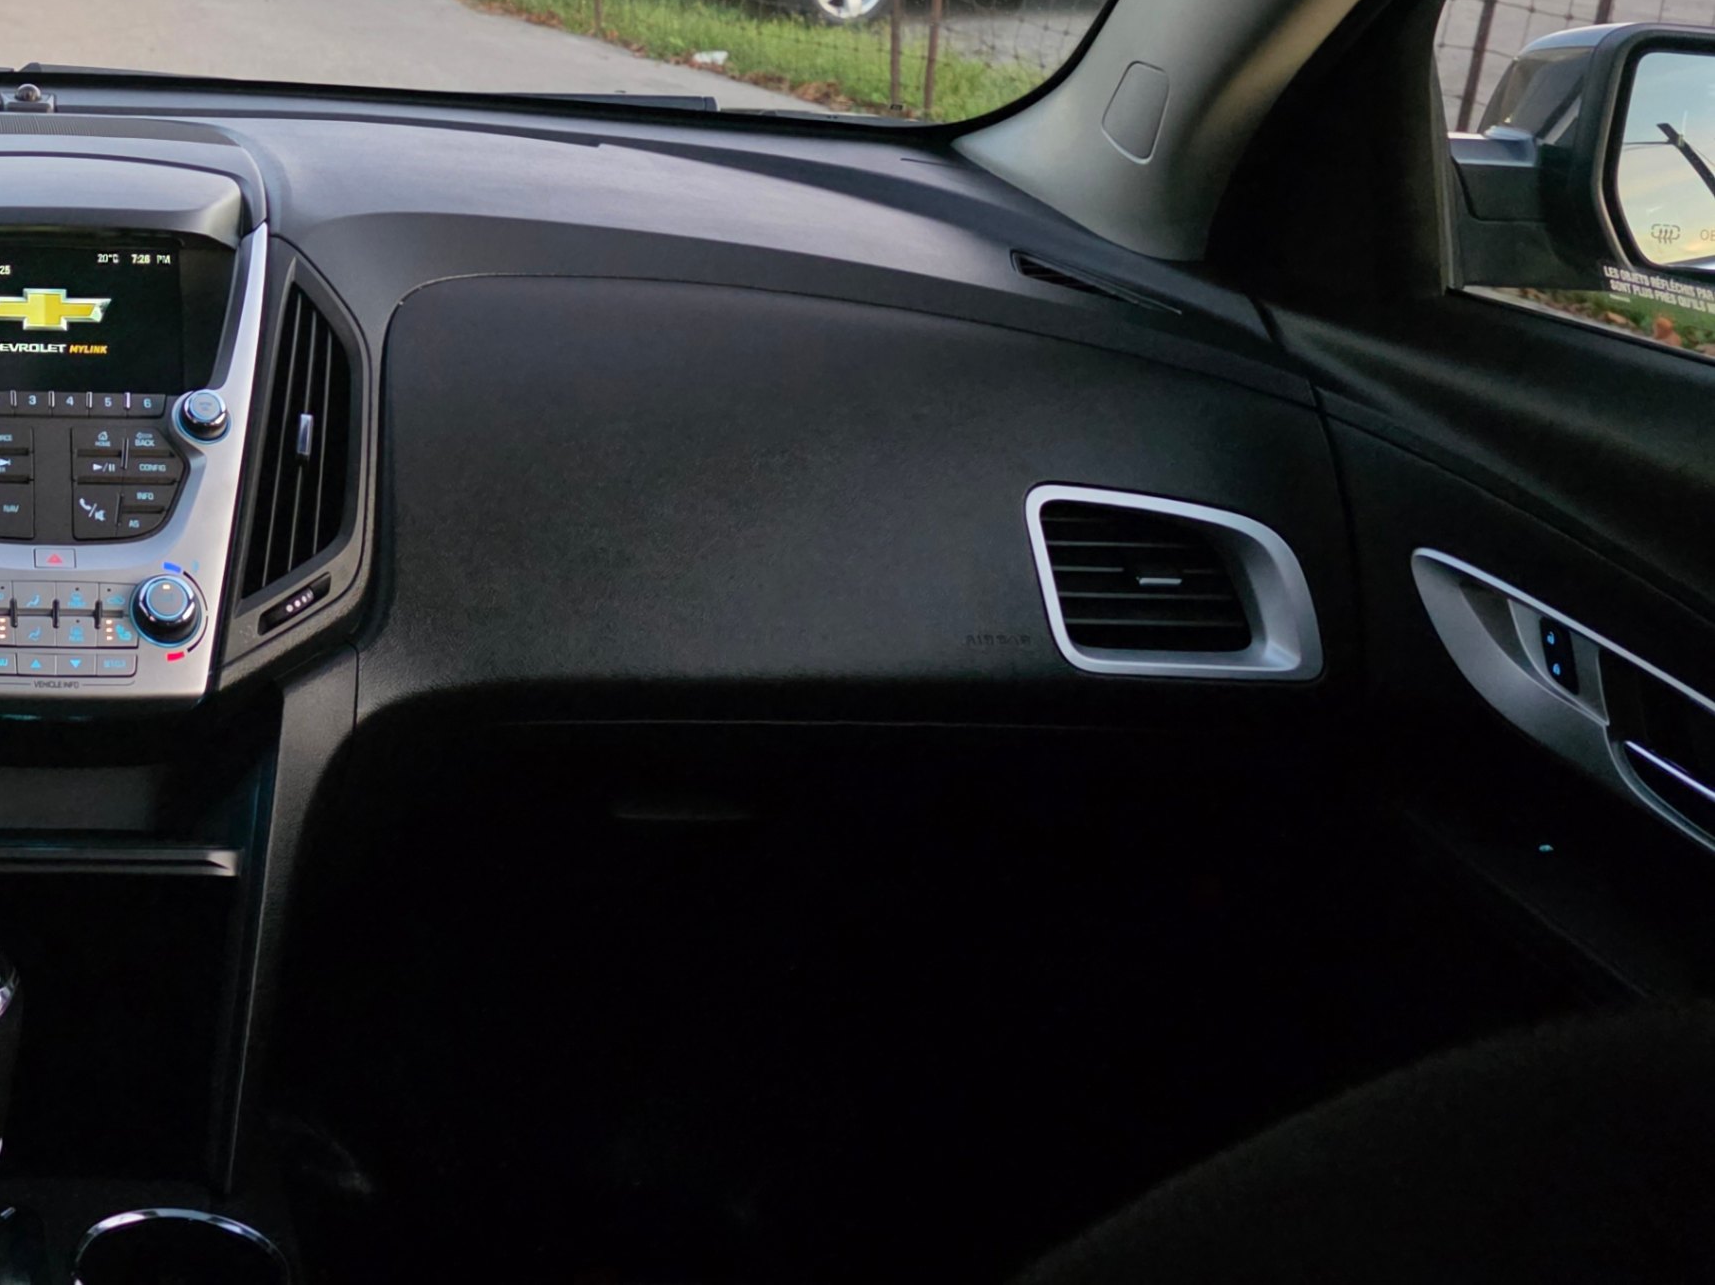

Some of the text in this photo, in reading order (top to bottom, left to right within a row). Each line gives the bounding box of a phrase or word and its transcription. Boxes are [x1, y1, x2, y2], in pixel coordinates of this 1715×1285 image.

[156, 255, 171, 264] PM
[1603, 265, 1620, 279] LES
[1620, 269, 1650, 286] OBJETS
[1610, 279, 1631, 294] SONT
[1632, 284, 1654, 299] PLUS
[69, 344, 108, 354] MYLINK
[28, 395, 37, 406] 3
[66, 396, 75, 406] 4
[104, 397, 112, 408] 5
[143, 398, 152, 409] 6
[135, 439, 155, 447] BACK
[139, 463, 166, 472] CONFIG
[136, 492, 154, 501] INFO
[3, 504, 19, 513] NAV
[34, 680, 79, 689] VEHICLE INFO
